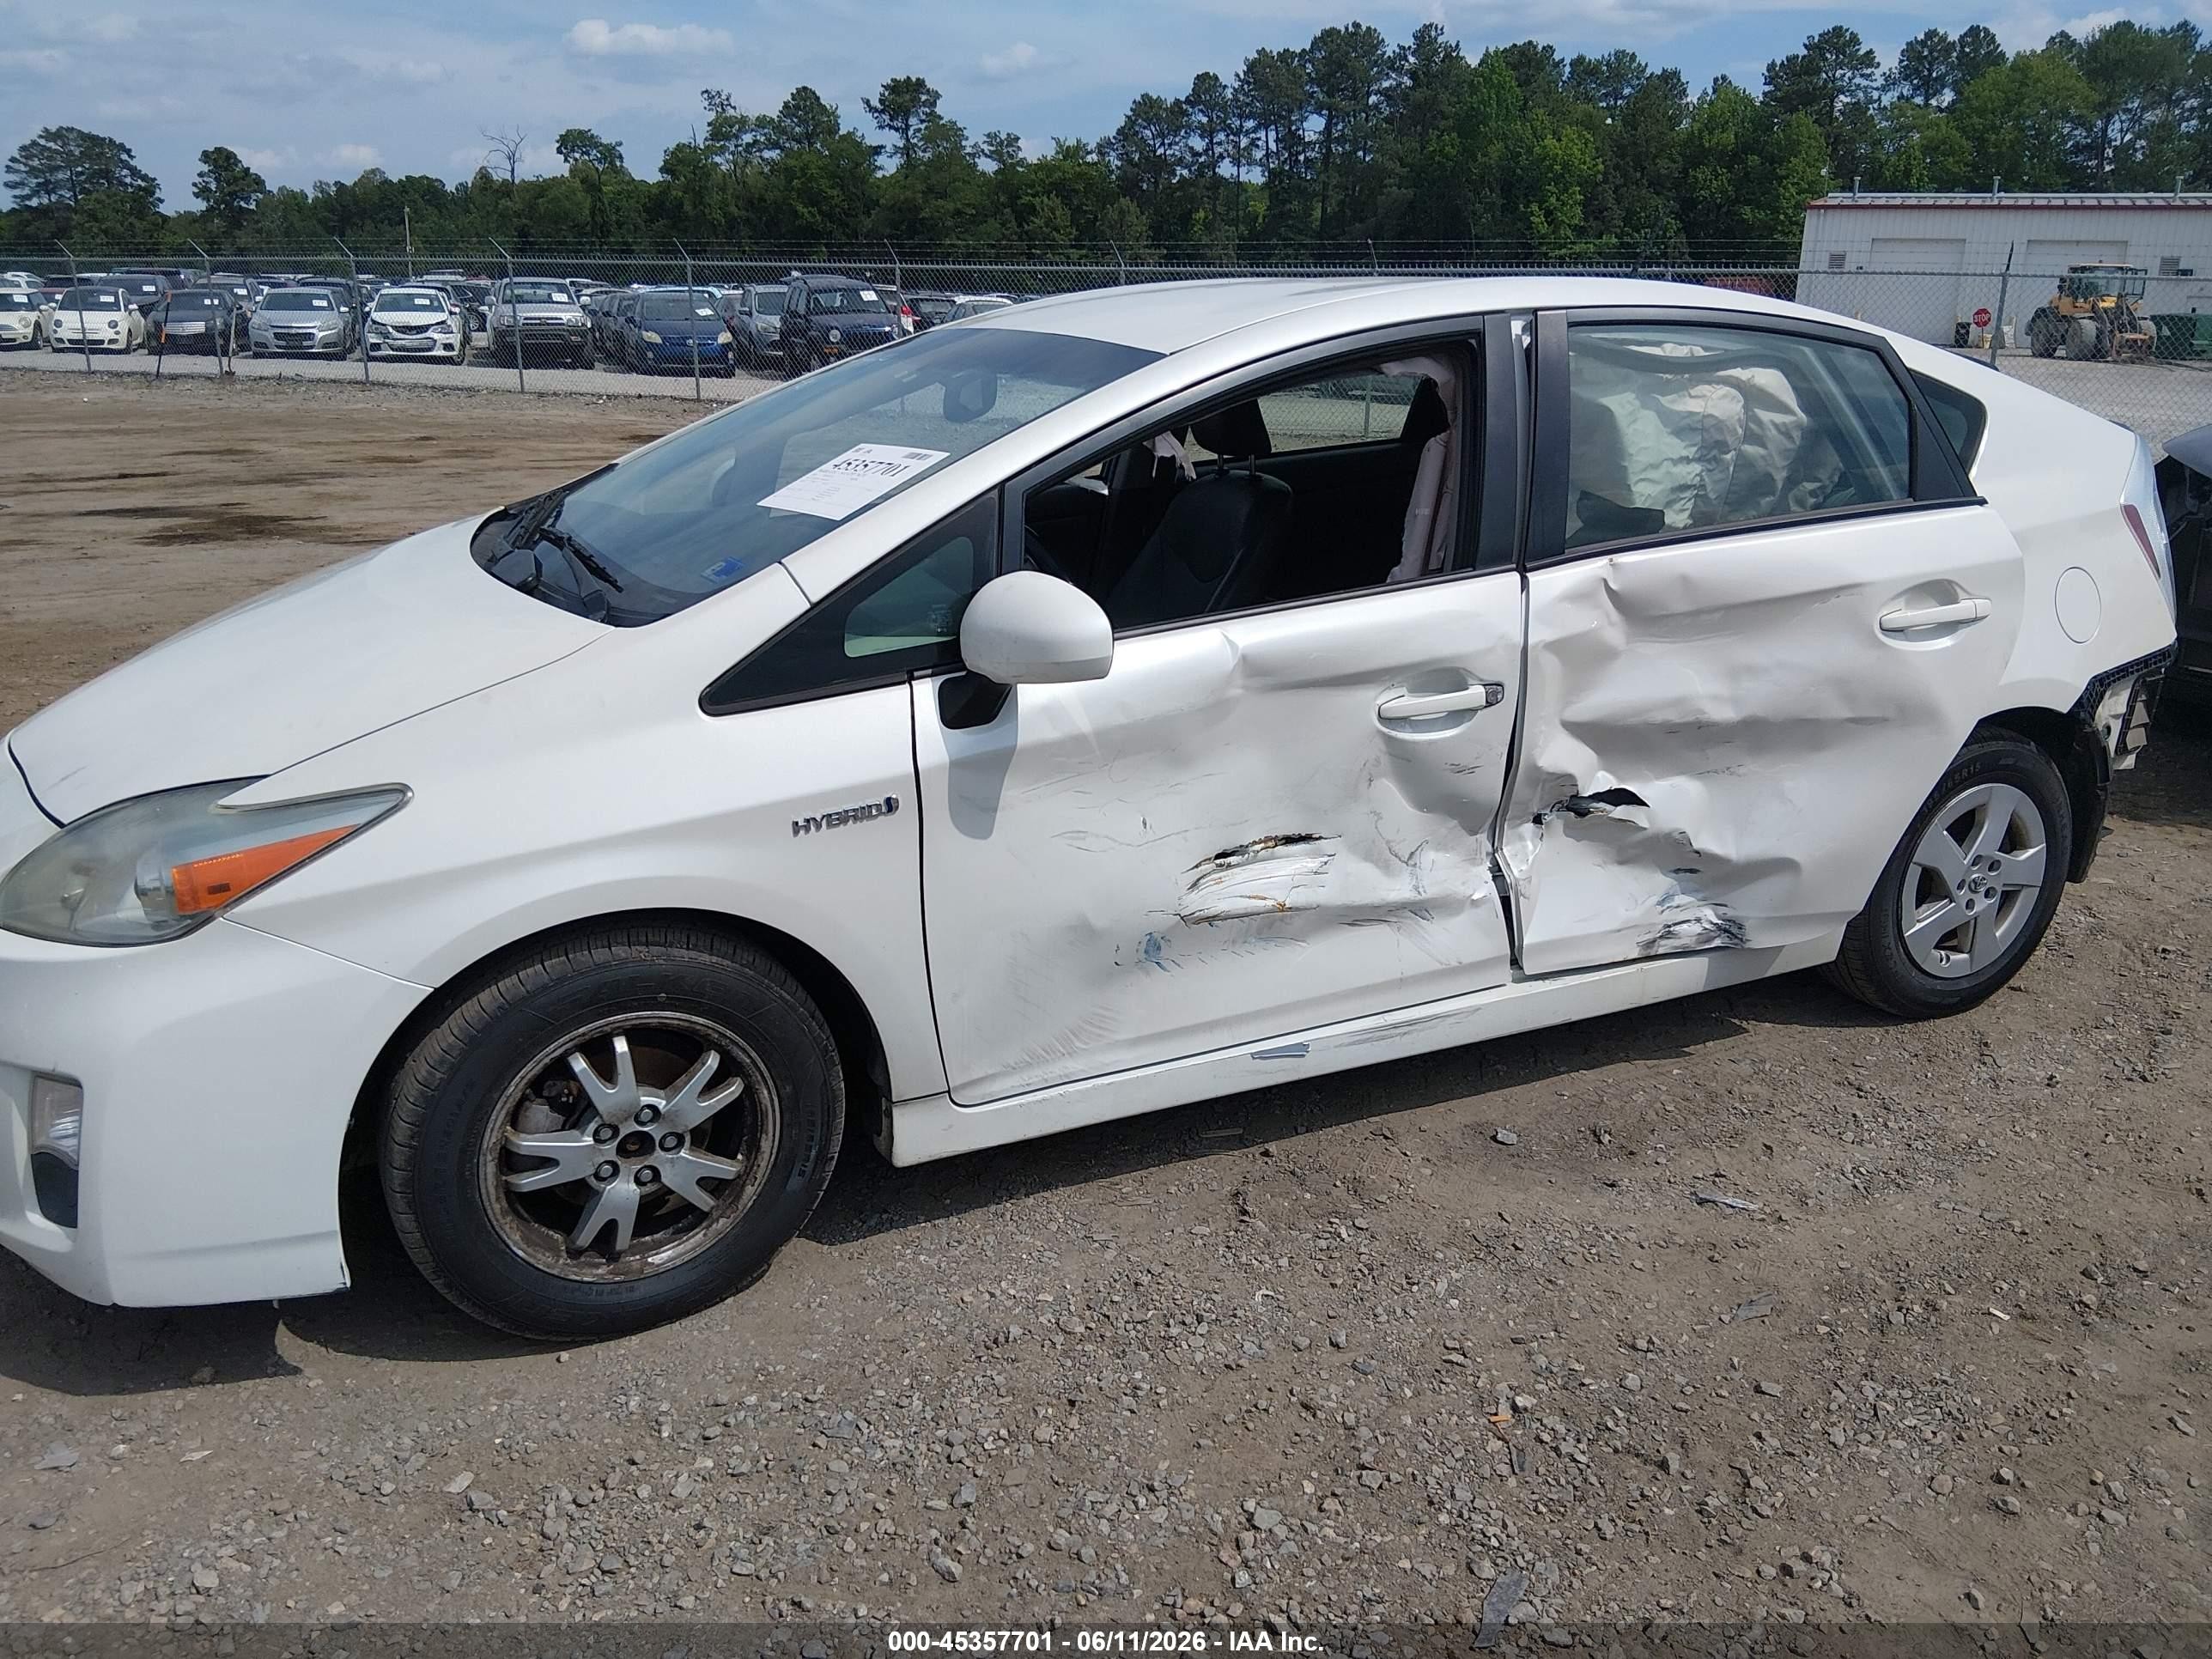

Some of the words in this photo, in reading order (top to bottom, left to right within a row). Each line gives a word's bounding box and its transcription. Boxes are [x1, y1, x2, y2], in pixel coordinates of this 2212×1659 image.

[1973, 314, 1990, 323] STOP
[832, 458, 911, 477] 45357701
[791, 801, 883, 838] HYBRID
